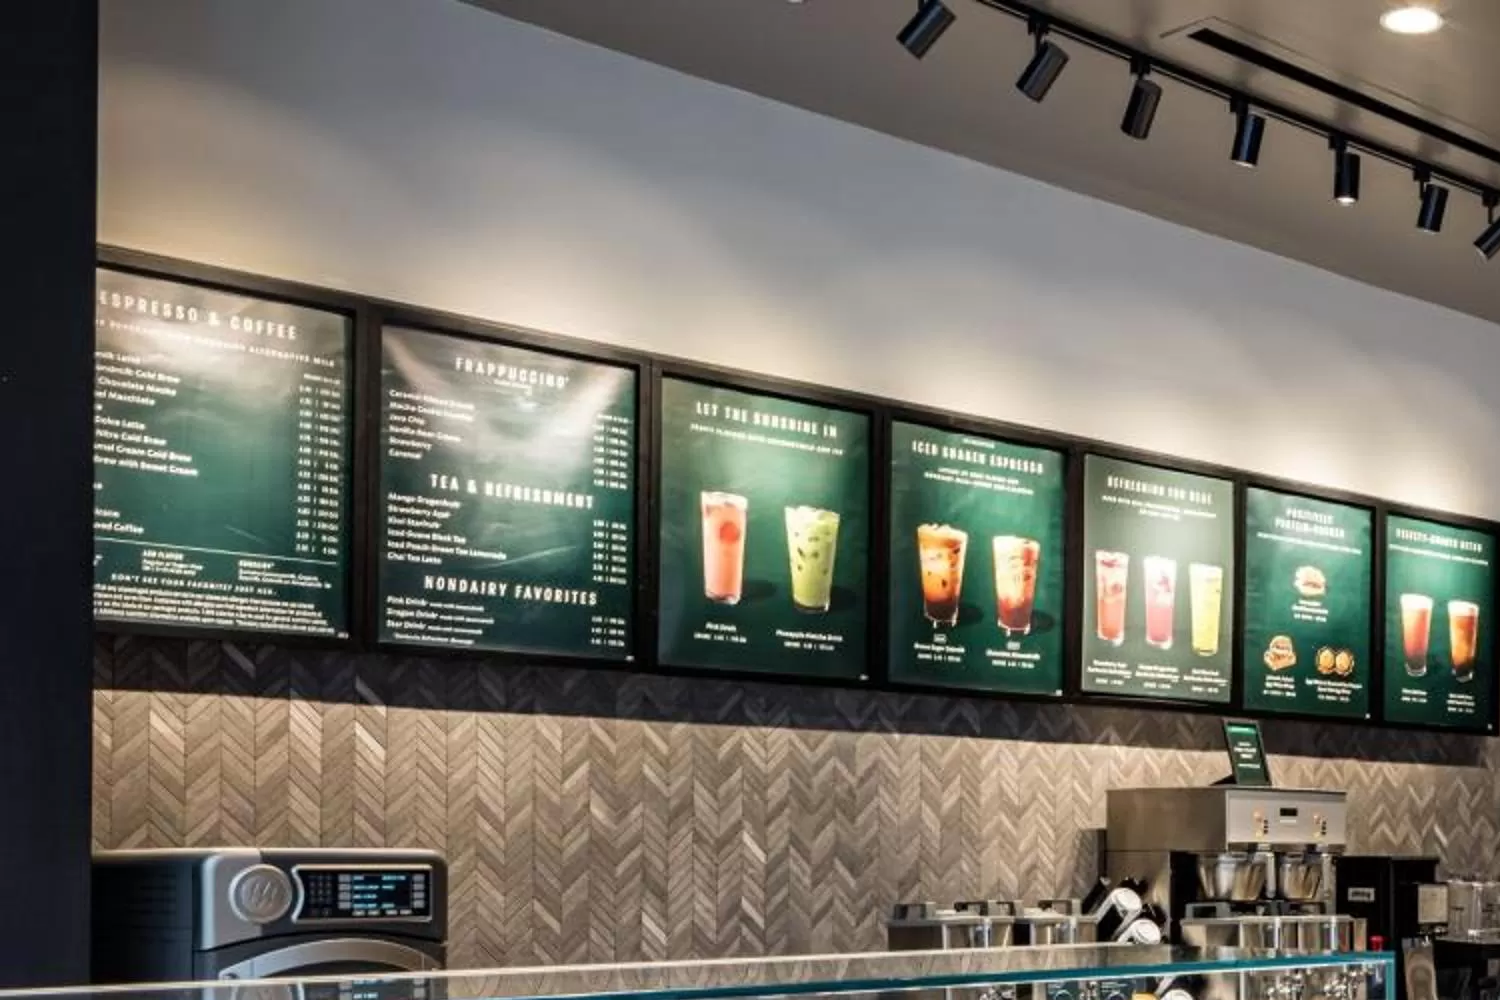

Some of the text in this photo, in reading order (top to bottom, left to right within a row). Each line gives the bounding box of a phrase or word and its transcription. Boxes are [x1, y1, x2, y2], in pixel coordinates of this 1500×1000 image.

[230, 315, 297, 340] COFFEE
[696, 401, 719, 418] LET
[430, 473, 460, 492] TEA
[424, 575, 597, 607] NONDAIRY FAVORITES
